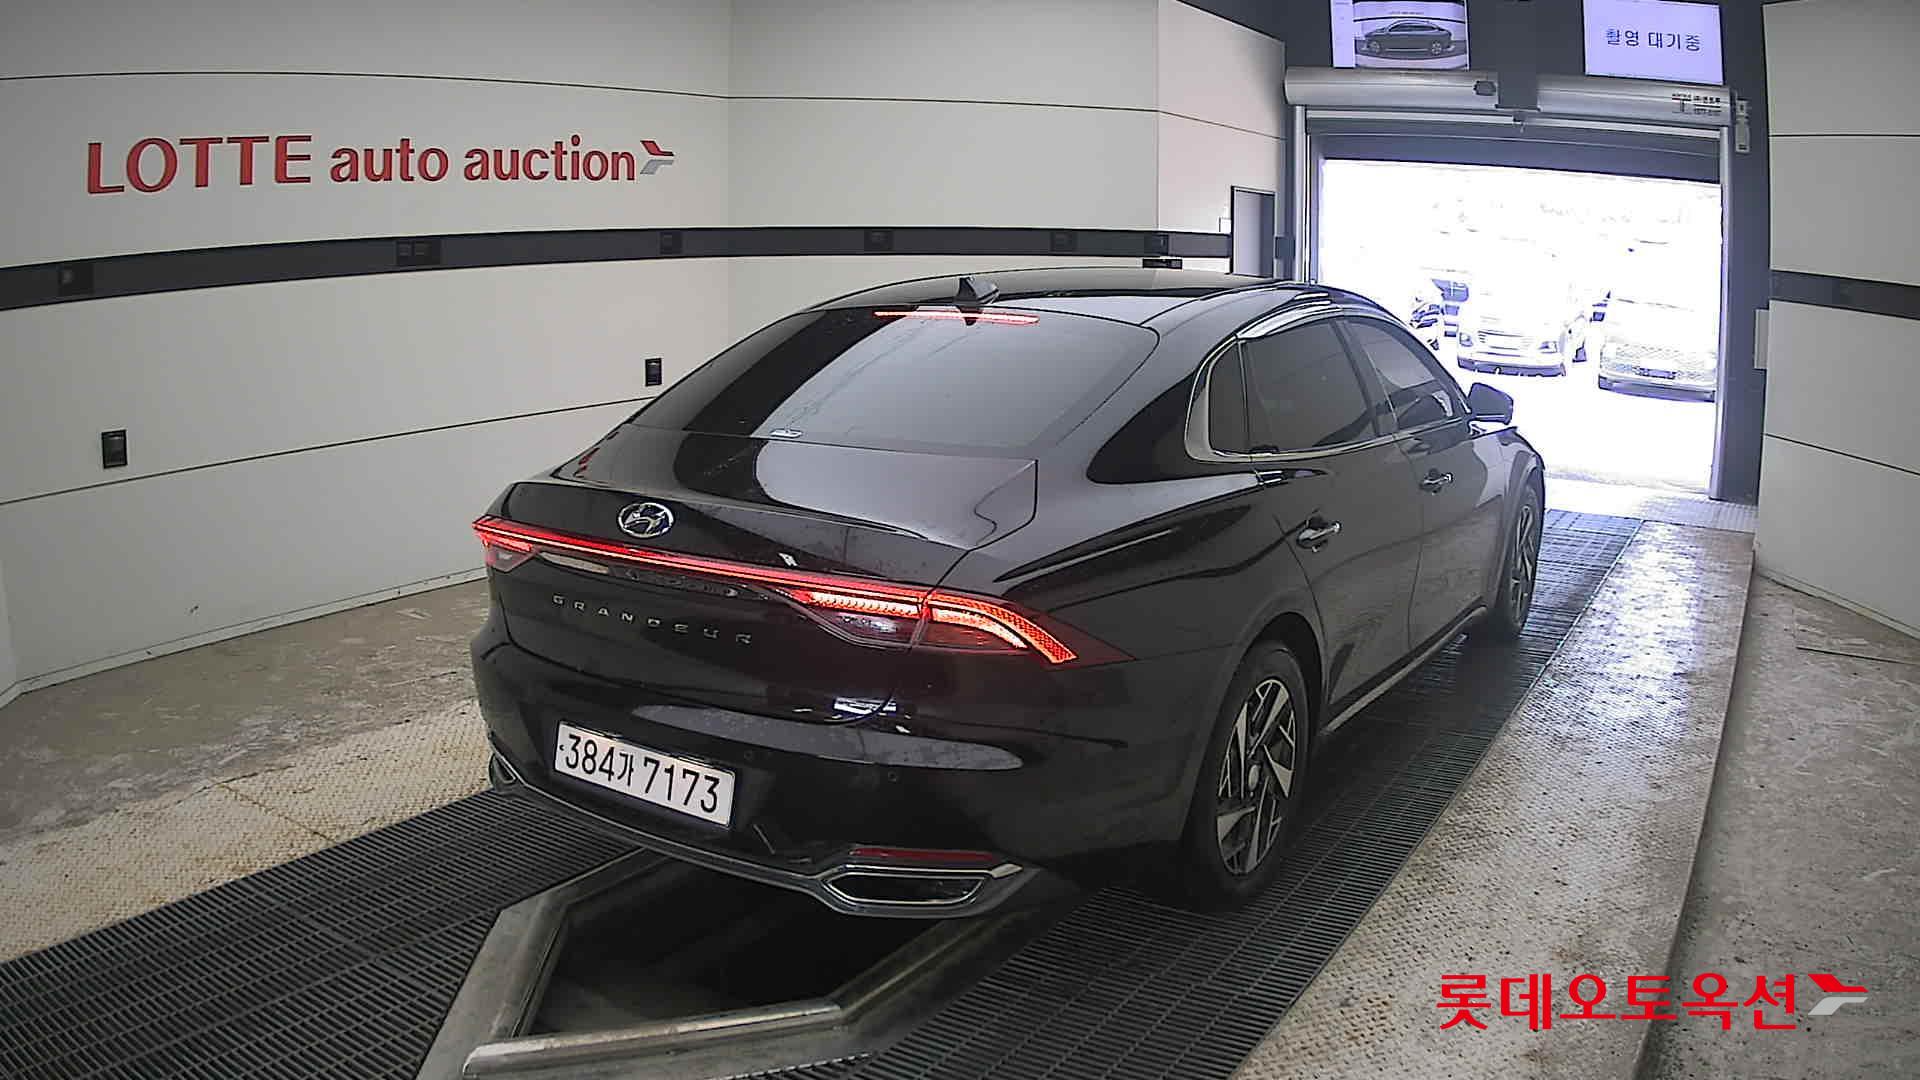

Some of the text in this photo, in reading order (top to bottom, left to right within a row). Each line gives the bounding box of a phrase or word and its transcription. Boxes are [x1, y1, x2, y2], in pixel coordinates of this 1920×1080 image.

[1606, 28, 1639, 47] 촬영
[87, 133, 636, 194] LOTTE auto auction
[553, 593, 752, 645] GRANDEUR
[643, 756, 721, 813] 7173
